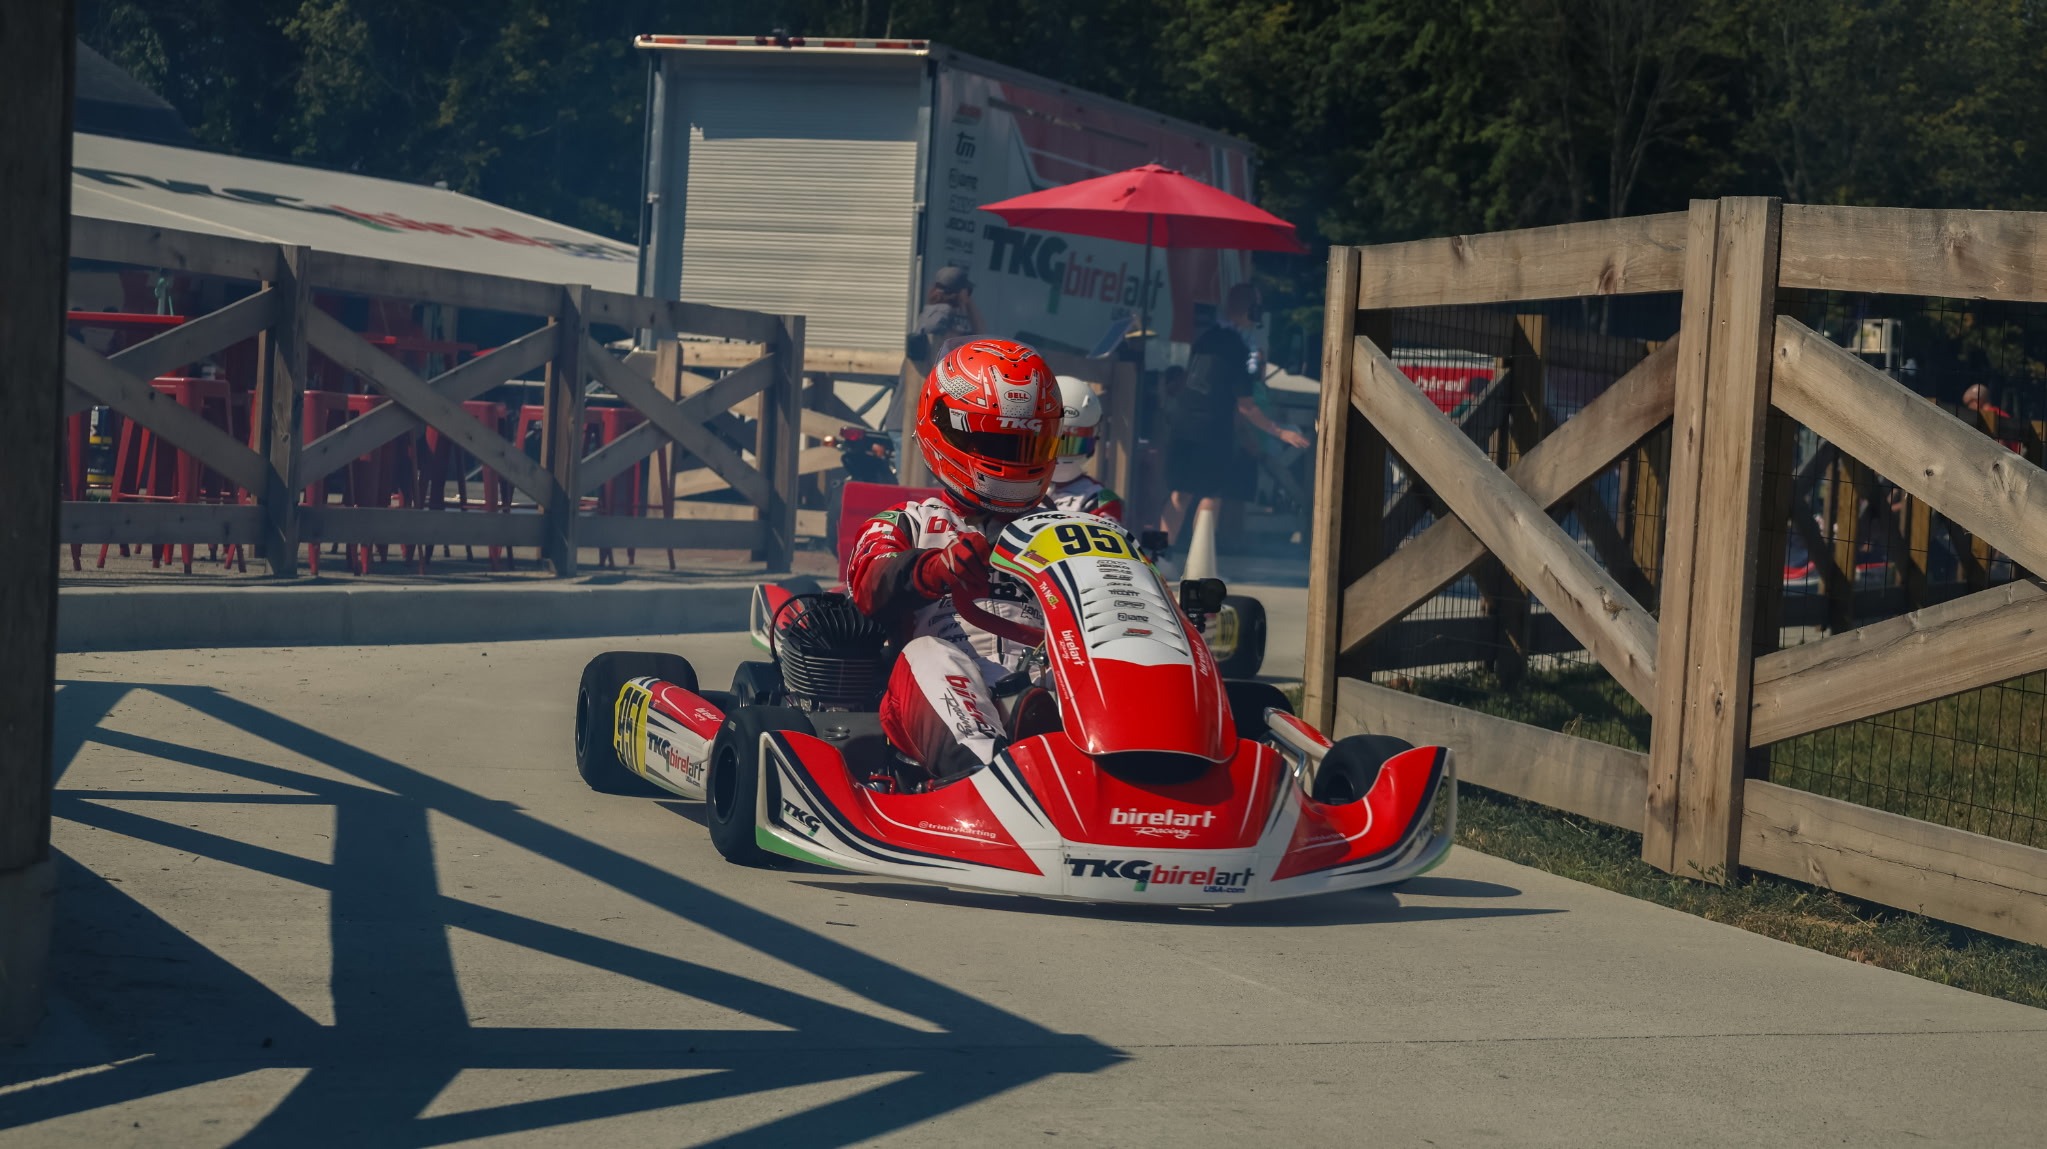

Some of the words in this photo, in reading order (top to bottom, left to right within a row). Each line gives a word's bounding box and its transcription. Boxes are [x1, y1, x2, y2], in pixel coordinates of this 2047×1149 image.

[982, 224, 1068, 314] TKG
[996, 416, 1042, 434] TKG
[1061, 629, 1085, 666] birelart
[647, 730, 672, 772] TKG
[669, 747, 705, 781] birelart
[782, 798, 822, 836] TKG
[1109, 807, 1216, 828] birelart
[1130, 826, 1200, 839] Racing
[1064, 857, 1154, 892] TKG
[1151, 864, 1255, 886] birelart
